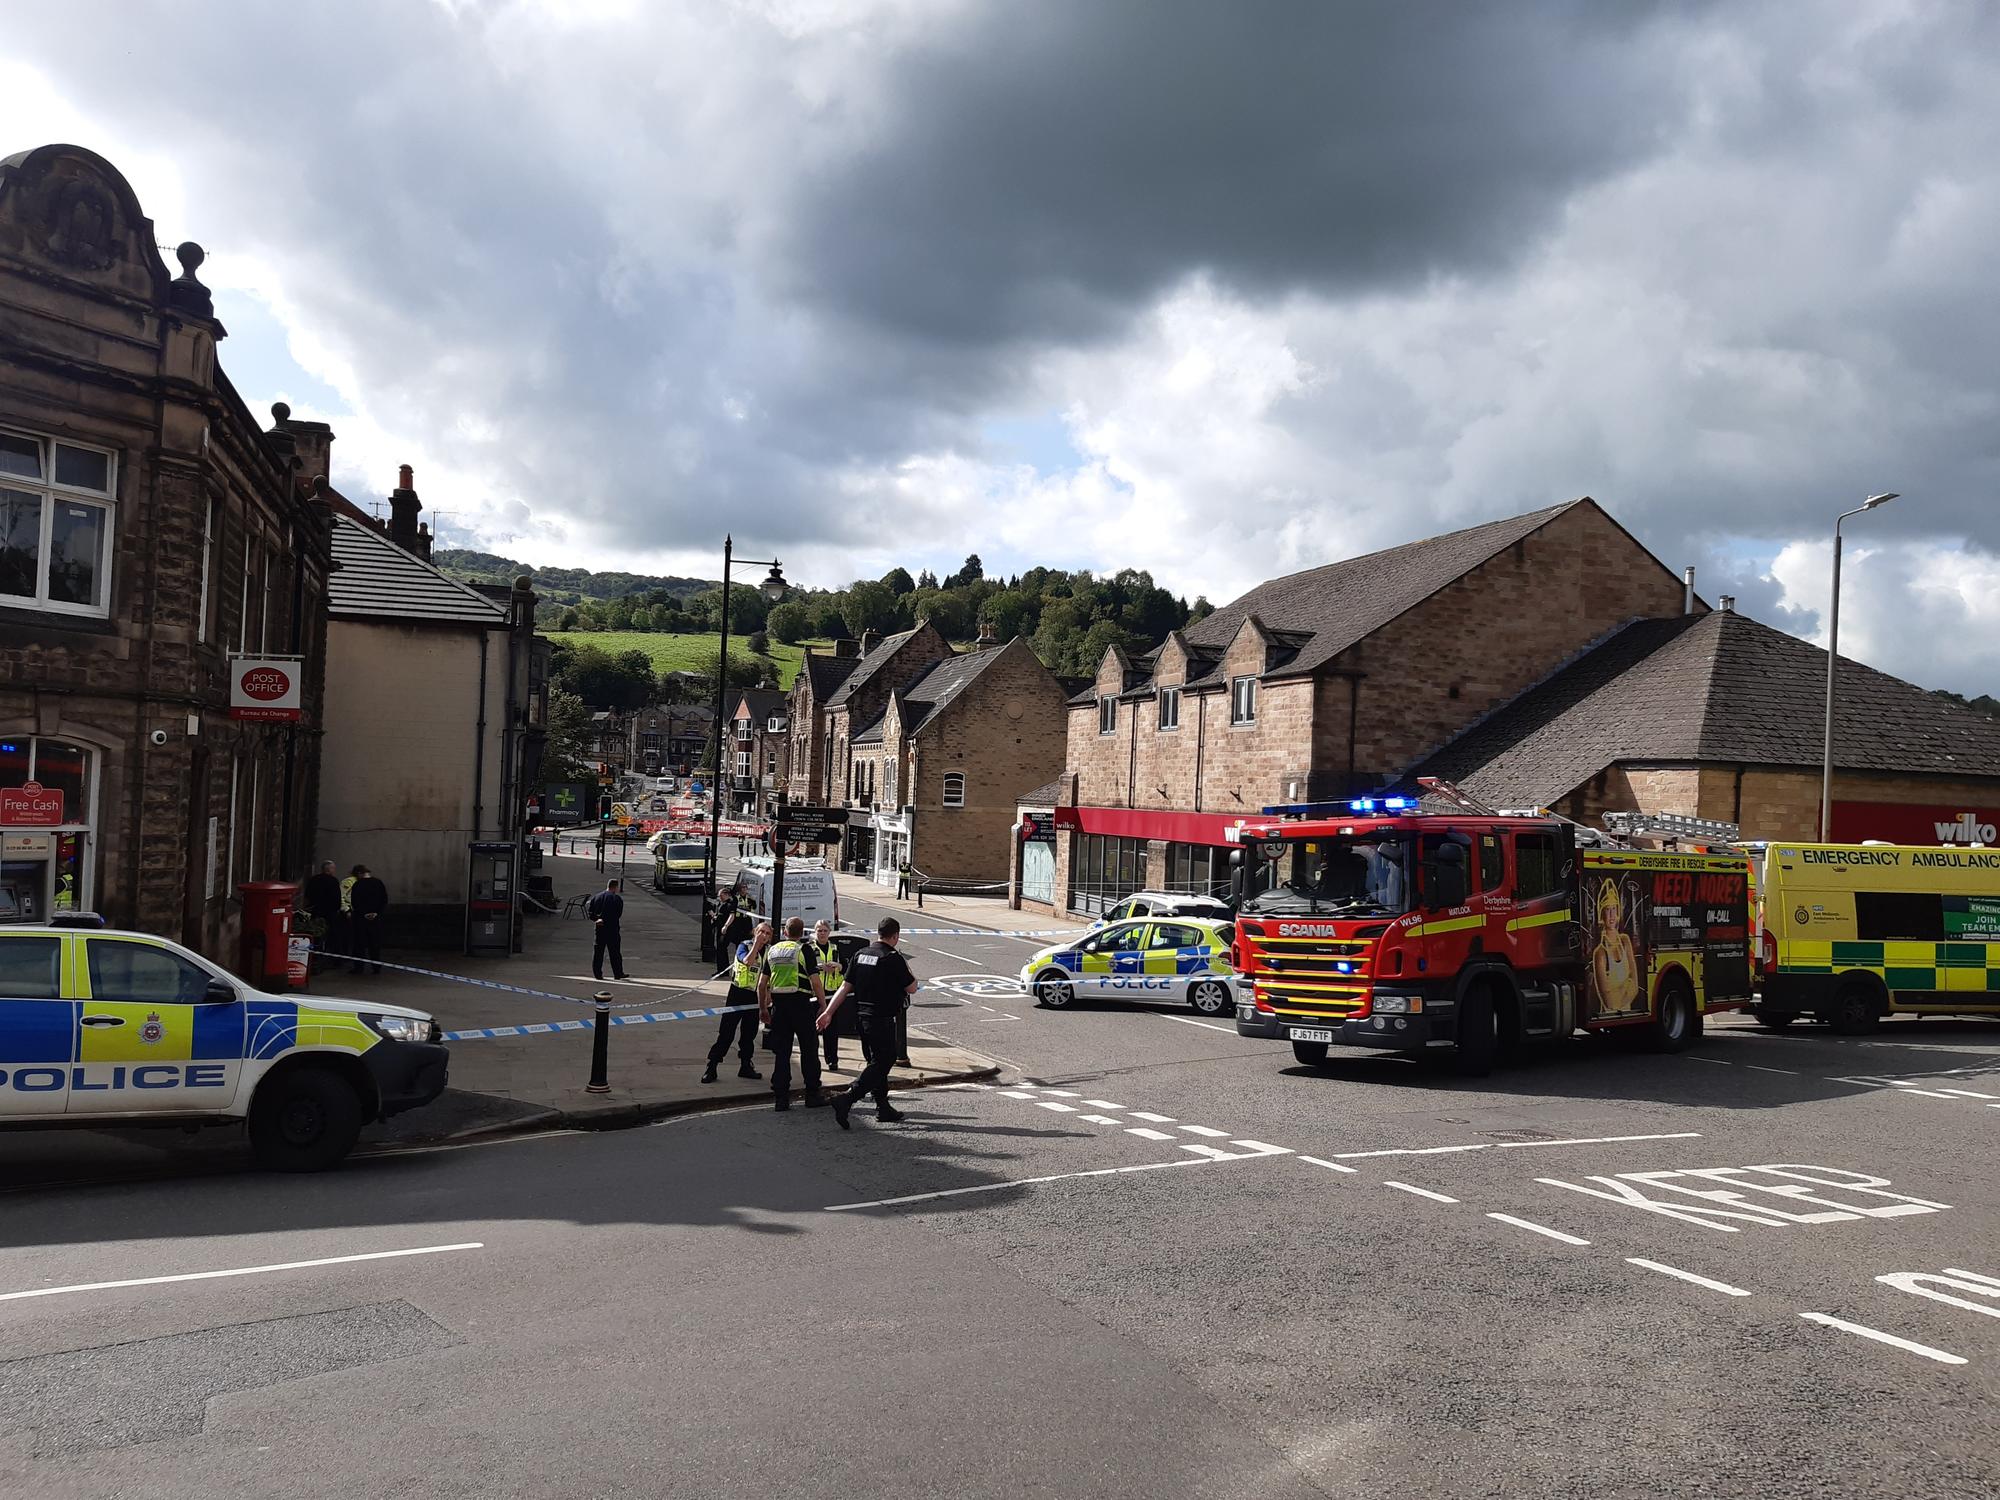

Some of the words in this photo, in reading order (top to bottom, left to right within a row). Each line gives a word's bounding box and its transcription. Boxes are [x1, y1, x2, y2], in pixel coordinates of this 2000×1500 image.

[252, 673, 281, 683] POST
[245, 683, 285, 693] OFFICE
[4, 798, 29, 810] Free
[32, 799, 59, 811] Cash
[548, 808, 580, 817] Pharmacy
[1224, 820, 1246, 843] wil
[1933, 813, 1997, 843] wilko
[1638, 856, 1669, 868] DERBYSHIRE
[1669, 857, 1681, 868] FIRE
[1681, 858, 1686, 868] &
[1686, 858, 1706, 869] RESCUE
[1802, 850, 1900, 866] EMERGENCY
[1911, 853, 2000, 868] AMBULANC
[1652, 873, 1693, 905] NEED
[1695, 873, 1743, 905] MORE?
[1483, 895, 1512, 906] Derbyshire
[1448, 906, 1472, 916] MATLOCK
[1706, 909, 1731, 924] ON-CALL
[1975, 915, 1997, 924] JOIN
[1278, 923, 1337, 937] SCANIA
[1961, 923, 1987, 931] TEAM
[1099, 975, 1171, 989] POLICE
[1293, 1029, 1312, 1039] FJ67
[1313, 1031, 1329, 1041] FTF
[0, 1065, 225, 1092] OLICE
[1533, 1163, 1954, 1232] KEEP
